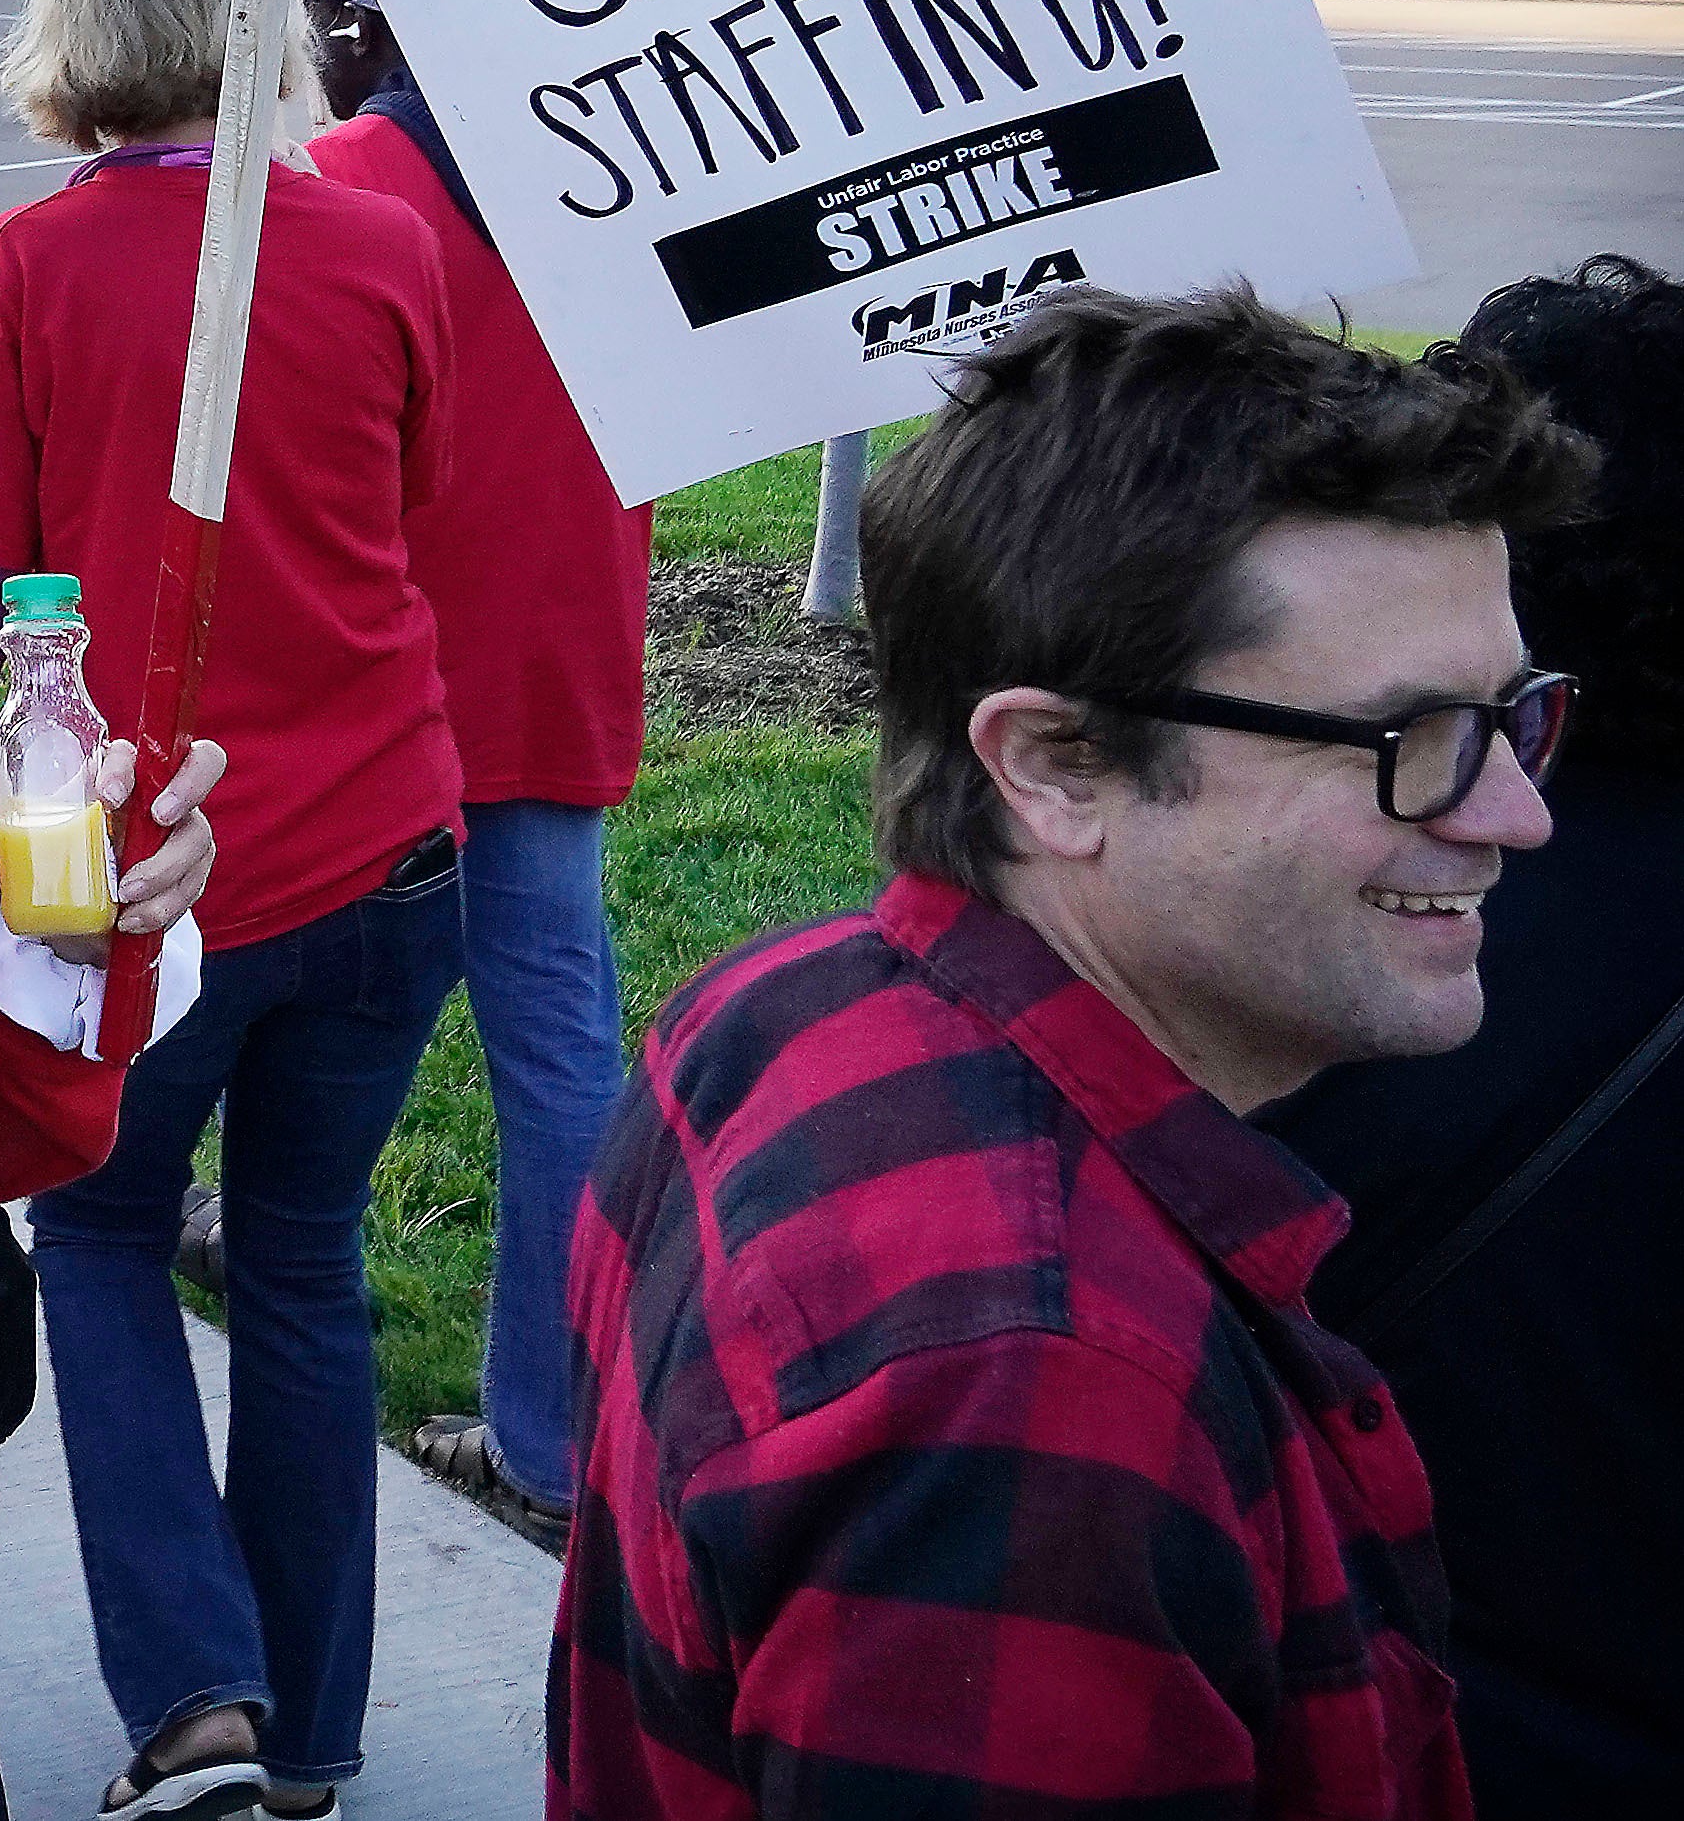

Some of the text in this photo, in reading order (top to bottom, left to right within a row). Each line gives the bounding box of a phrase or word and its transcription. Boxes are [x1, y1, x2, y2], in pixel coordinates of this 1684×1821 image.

[816, 145, 1074, 273] STRIKE
[817, 128, 1045, 209] Unfair Labor Practice
[862, 328, 941, 363] Minnesota
[943, 308, 997, 340] Nurses
[863, 247, 1088, 348] MNA
